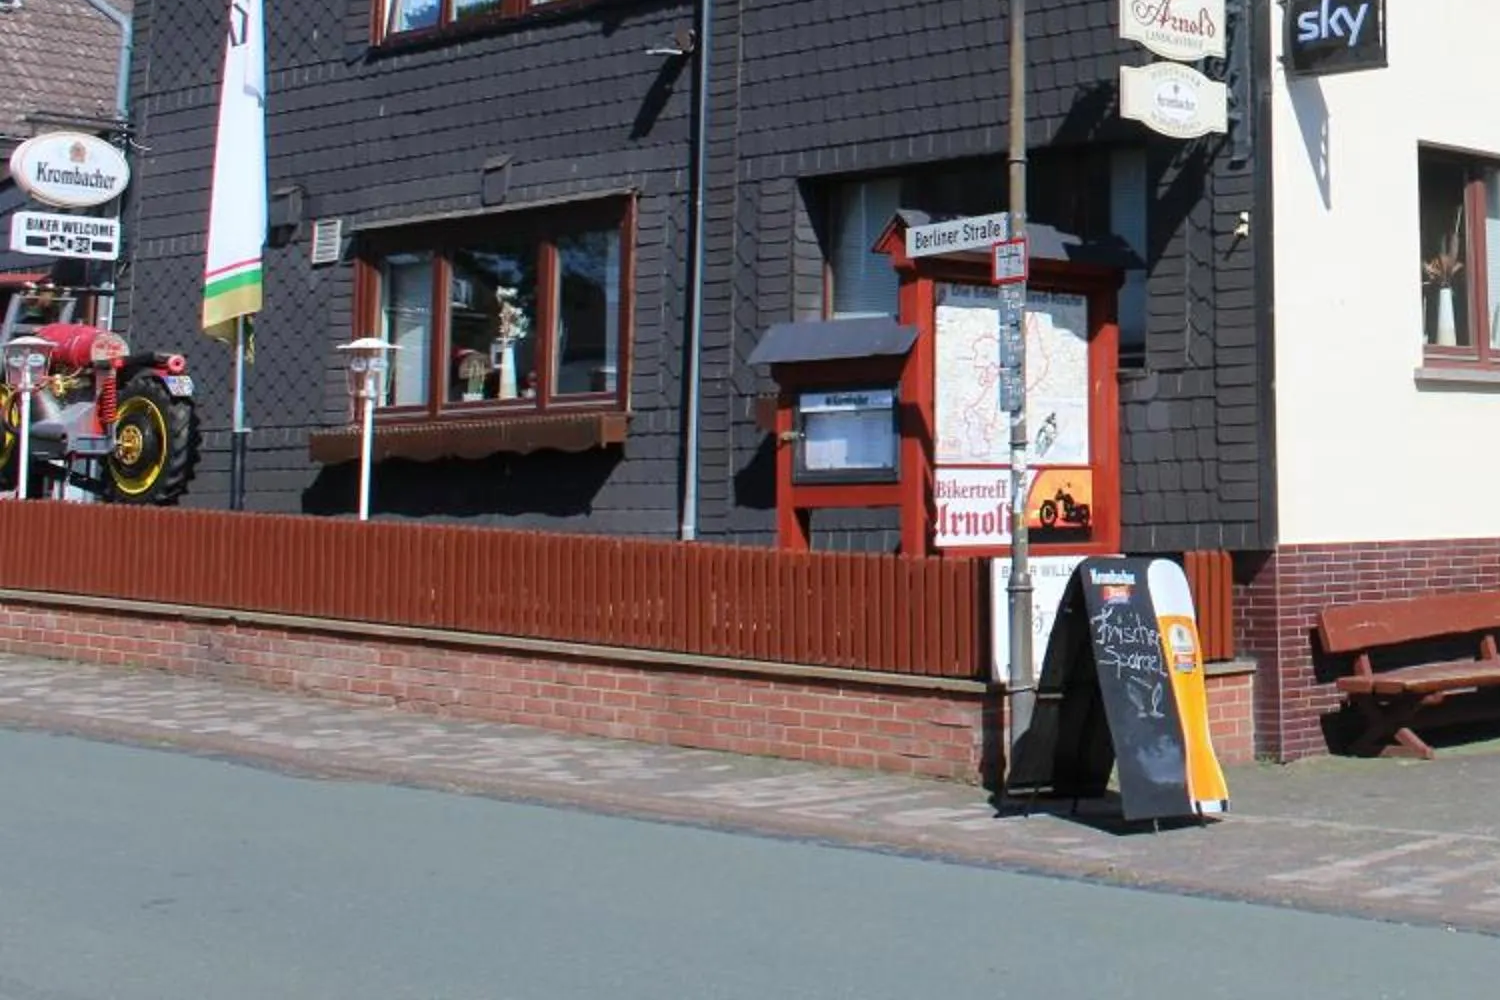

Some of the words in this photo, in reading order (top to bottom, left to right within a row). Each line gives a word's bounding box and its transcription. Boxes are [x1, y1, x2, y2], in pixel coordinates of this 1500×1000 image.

[36, 161, 117, 190] Krombacher
[26, 217, 60, 233] BIKER
[62, 221, 116, 237] WELCOME
[915, 227, 959, 249] Berliner
[962, 219, 1002, 242] Straße
[935, 479, 1009, 499] Bikertreff
